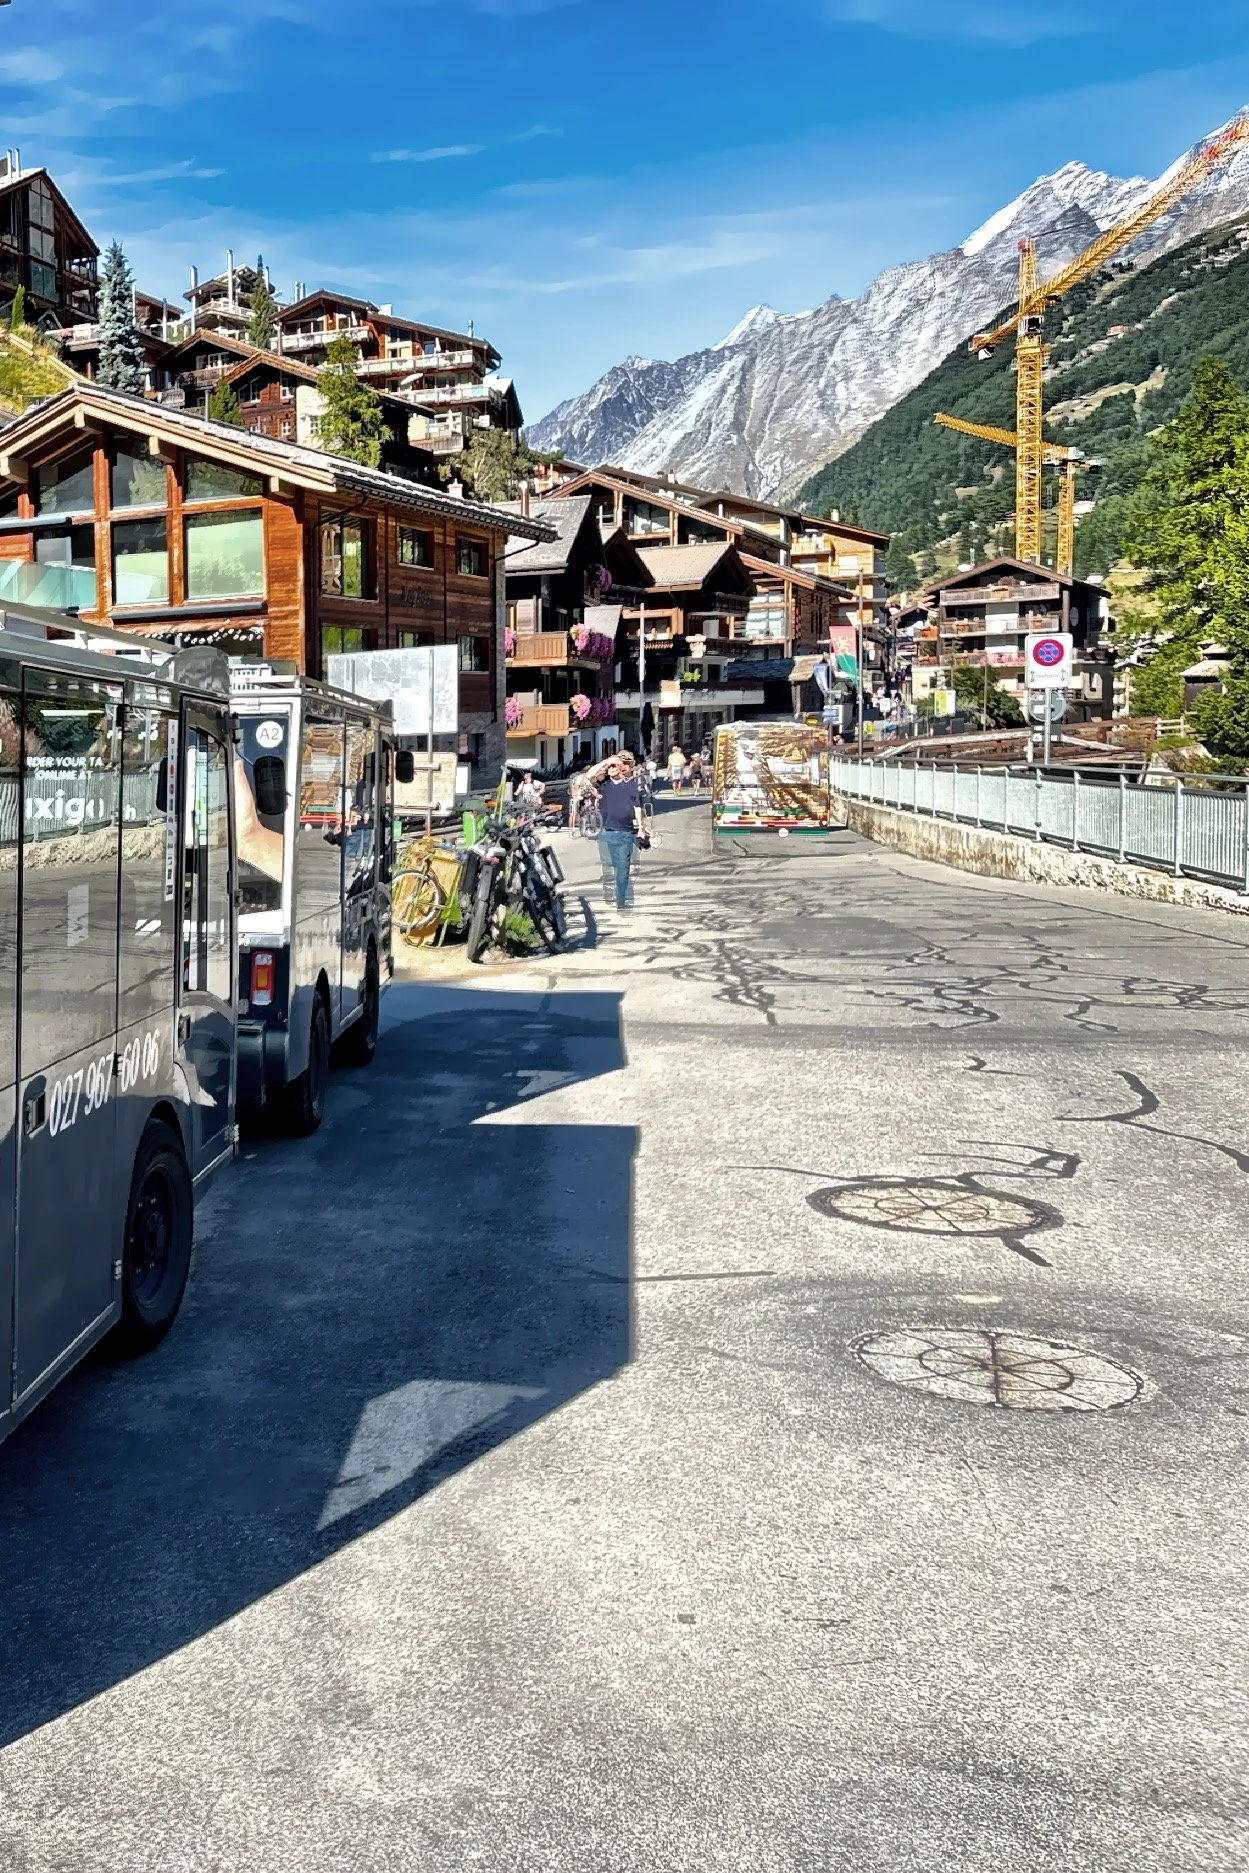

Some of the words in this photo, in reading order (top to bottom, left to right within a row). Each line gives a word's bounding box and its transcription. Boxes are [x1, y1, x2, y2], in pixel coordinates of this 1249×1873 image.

[259, 727, 280, 741] A2
[26, 756, 54, 768] RDER
[55, 756, 87, 768] YOUR
[88, 756, 103, 768] TA
[34, 770, 78, 780] ONLINE
[78, 770, 94, 780] AT
[49, 1068, 84, 1137] 027
[84, 1050, 115, 1116] 967
[120, 1037, 141, 1093] 60
[142, 1028, 161, 1080] 06
